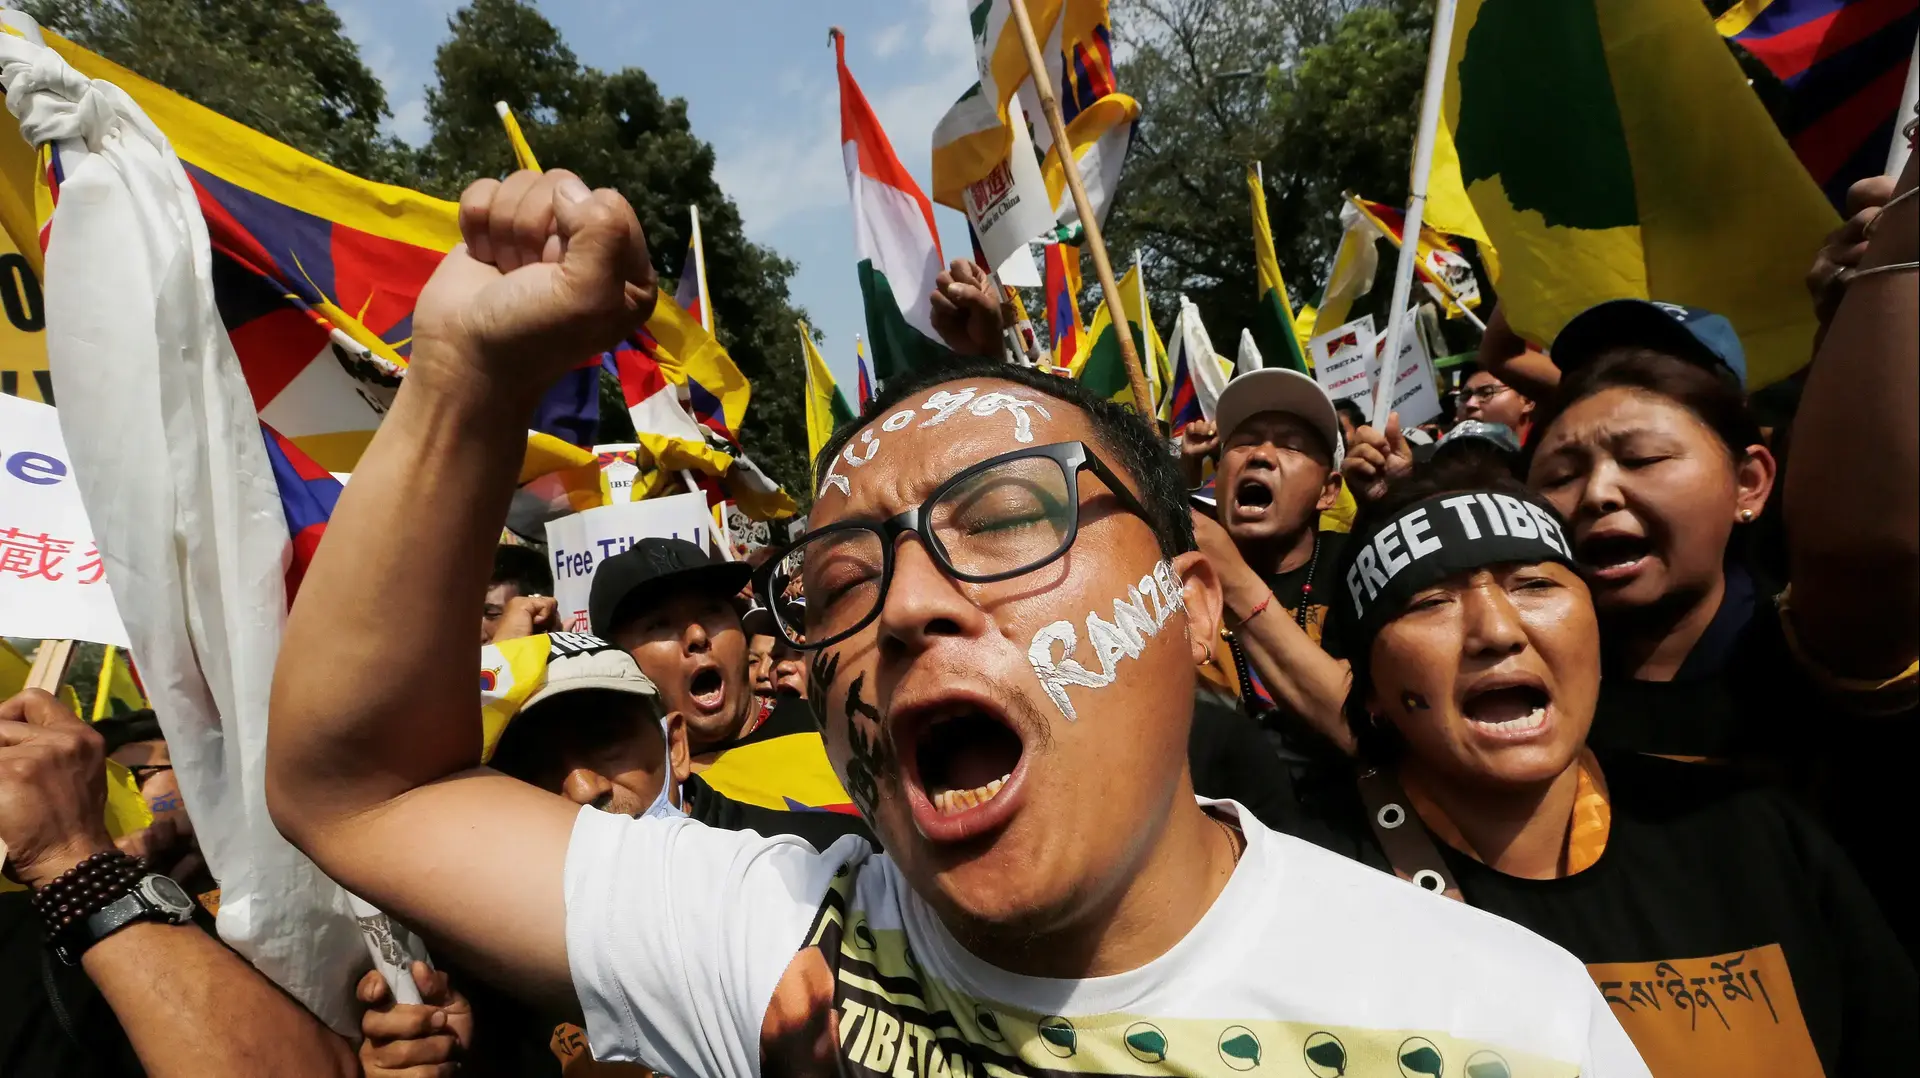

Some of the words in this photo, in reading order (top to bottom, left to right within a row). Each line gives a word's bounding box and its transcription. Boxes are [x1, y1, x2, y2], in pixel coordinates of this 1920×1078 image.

[998, 194, 1021, 217] China
[1325, 353, 1364, 373] TIBETAN
[1394, 363, 1420, 386] ANDS
[1328, 370, 1367, 390] DEMAND
[609, 479, 633, 489] IBE
[555, 549, 594, 581] Free
[1346, 507, 1443, 620] FREE
